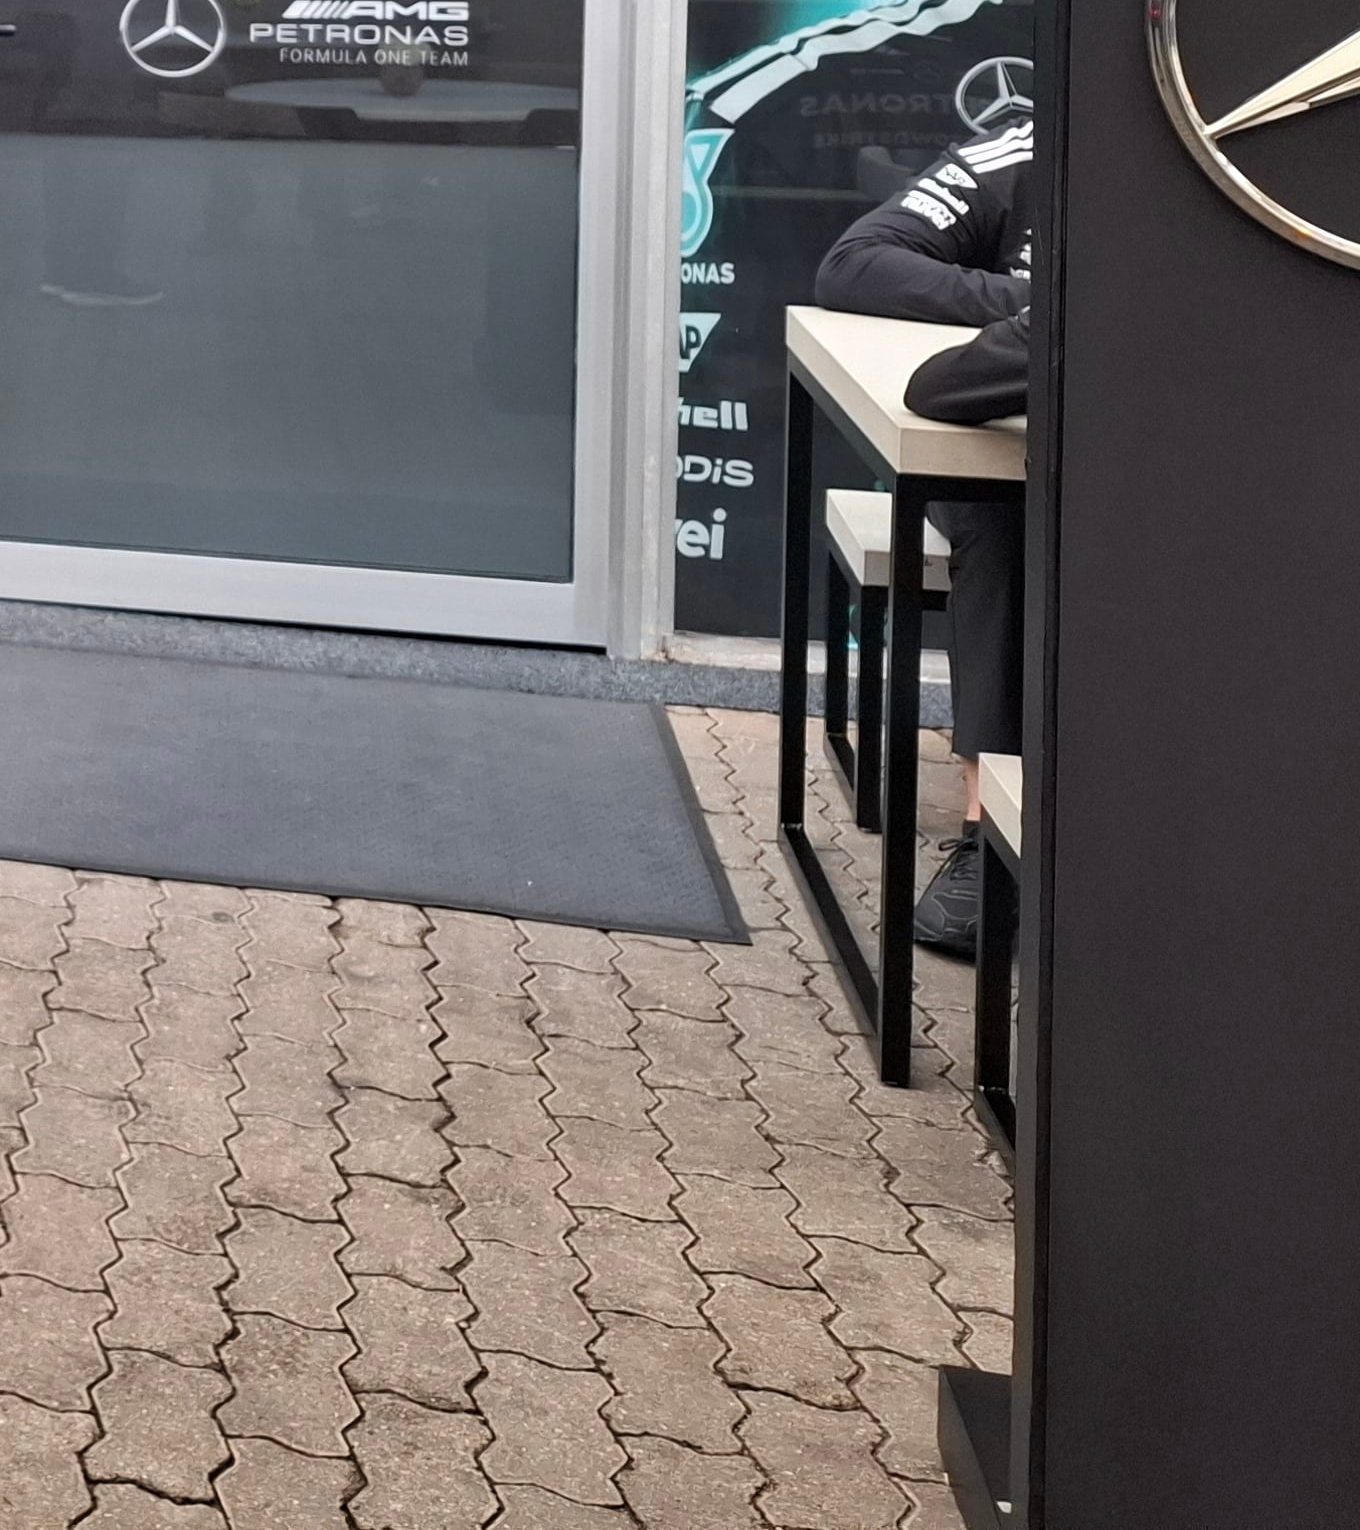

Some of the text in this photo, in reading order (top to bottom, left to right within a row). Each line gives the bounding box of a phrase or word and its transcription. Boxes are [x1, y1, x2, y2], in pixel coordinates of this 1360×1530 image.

[341, 0, 469, 21] AMG
[249, 23, 469, 47] PETRONAS
[280, 47, 469, 66] FORMULA ONE TEAM
